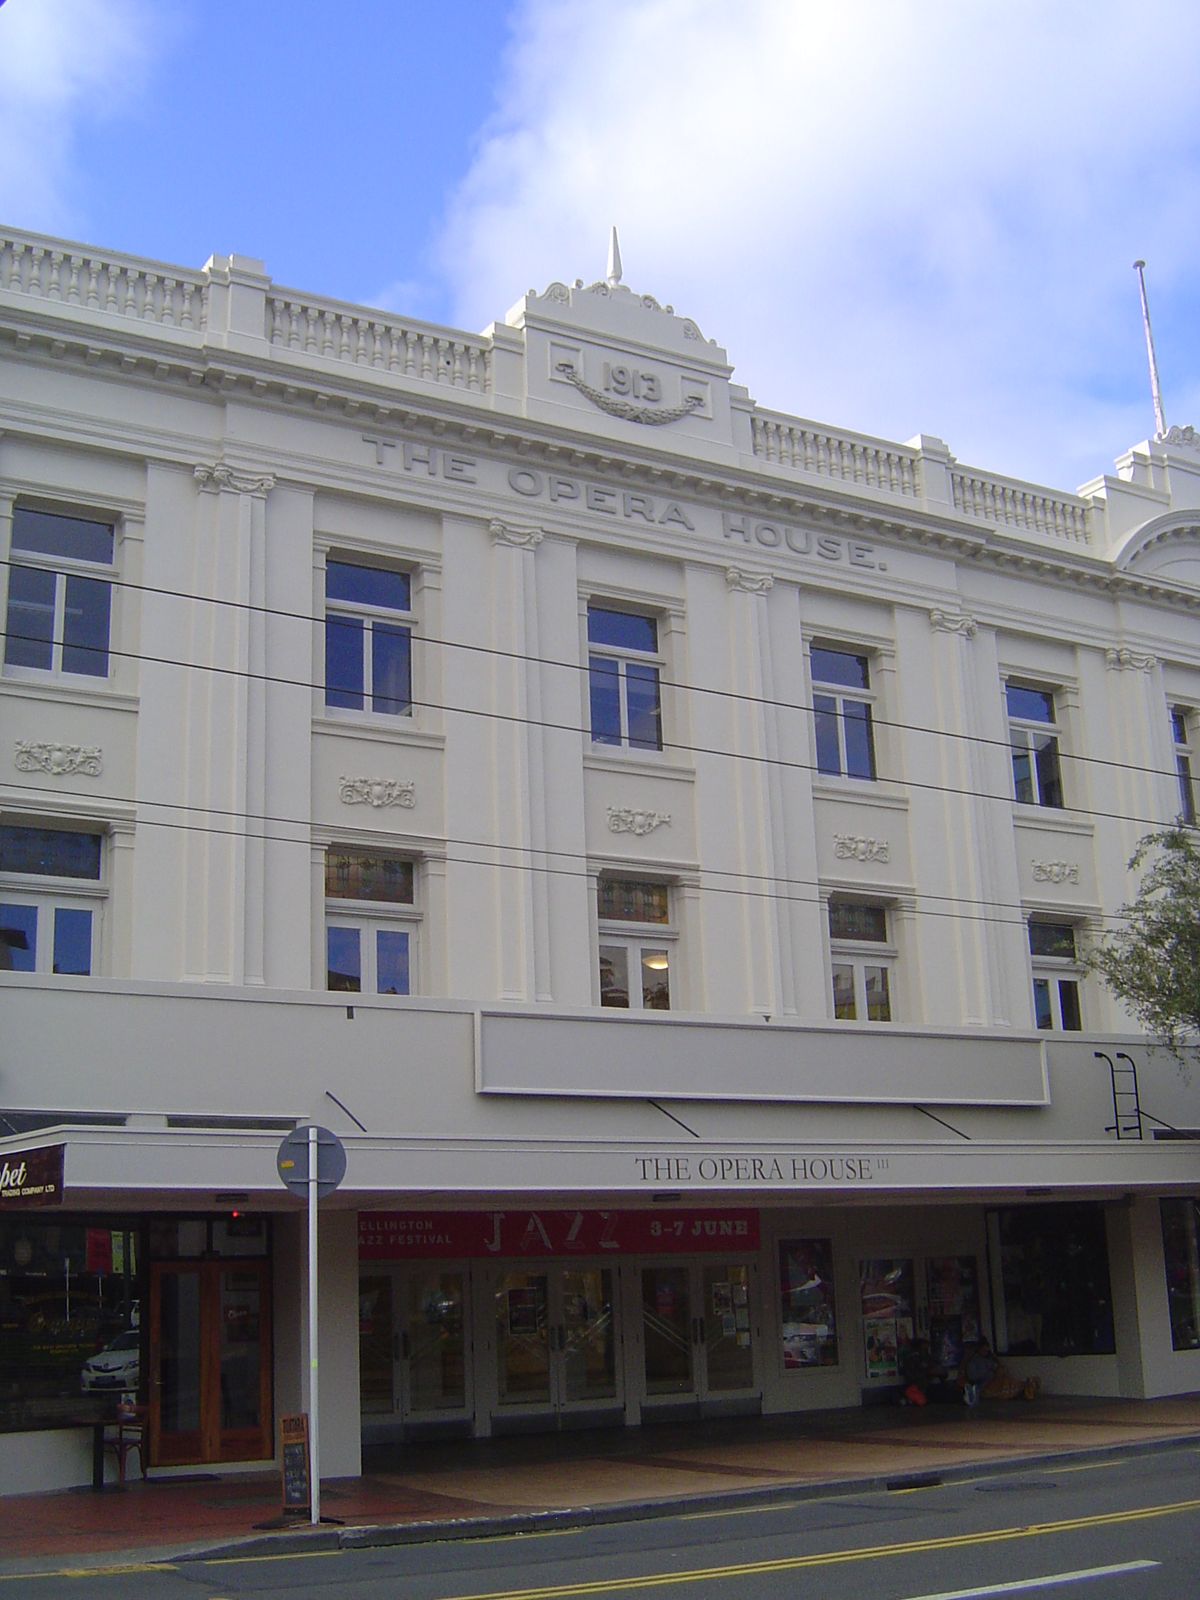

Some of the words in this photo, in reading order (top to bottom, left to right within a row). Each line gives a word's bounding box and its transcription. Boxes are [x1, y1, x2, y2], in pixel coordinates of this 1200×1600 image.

[602, 361, 662, 402] 1913
[361, 433, 477, 485] THE
[507, 466, 696, 532] OPERA
[0, 1161, 28, 1191] pet
[634, 1157, 692, 1182] THE
[697, 1157, 784, 1181] OPERA
[791, 1157, 873, 1181] HOUSE
[21, 1185, 44, 1196] COMPANY
[45, 1184, 55, 1193] LTD
[358, 1219, 434, 1232] ELLINGTON
[483, 1210, 620, 1252] JAZZ
[691, 1219, 749, 1237] JUNE
[358, 1234, 384, 1246] AZZ
[389, 1233, 453, 1245] FESTIVAL
